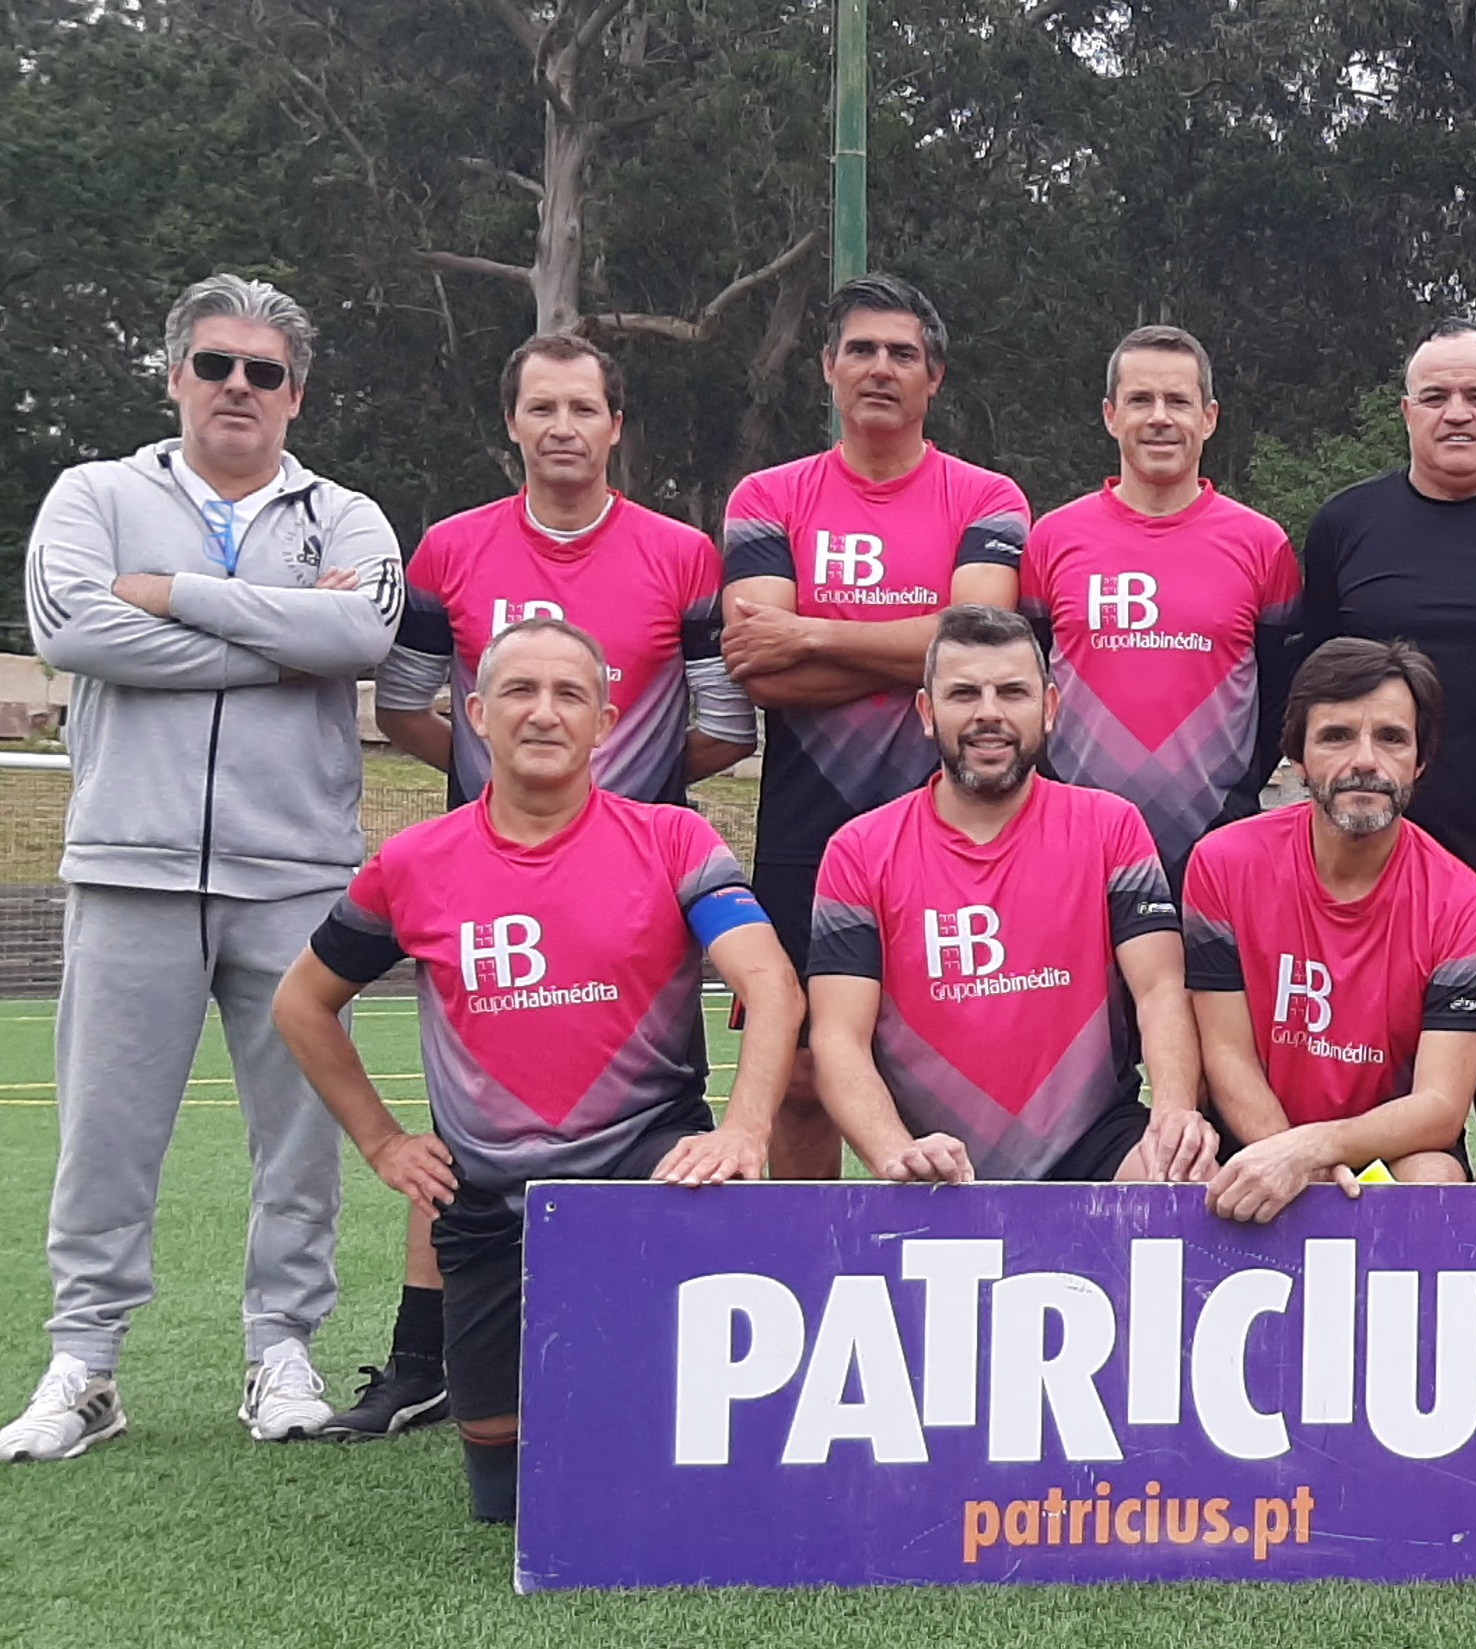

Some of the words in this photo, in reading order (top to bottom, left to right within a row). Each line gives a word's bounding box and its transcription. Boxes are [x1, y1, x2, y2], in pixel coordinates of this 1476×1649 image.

[814, 530, 884, 587] HB
[1088, 571, 1159, 631] HB
[460, 914, 547, 991] HB
[924, 904, 1005, 978] HB
[1273, 953, 1332, 1032] HB
[962, 1481, 1316, 1564] patricius.pt
